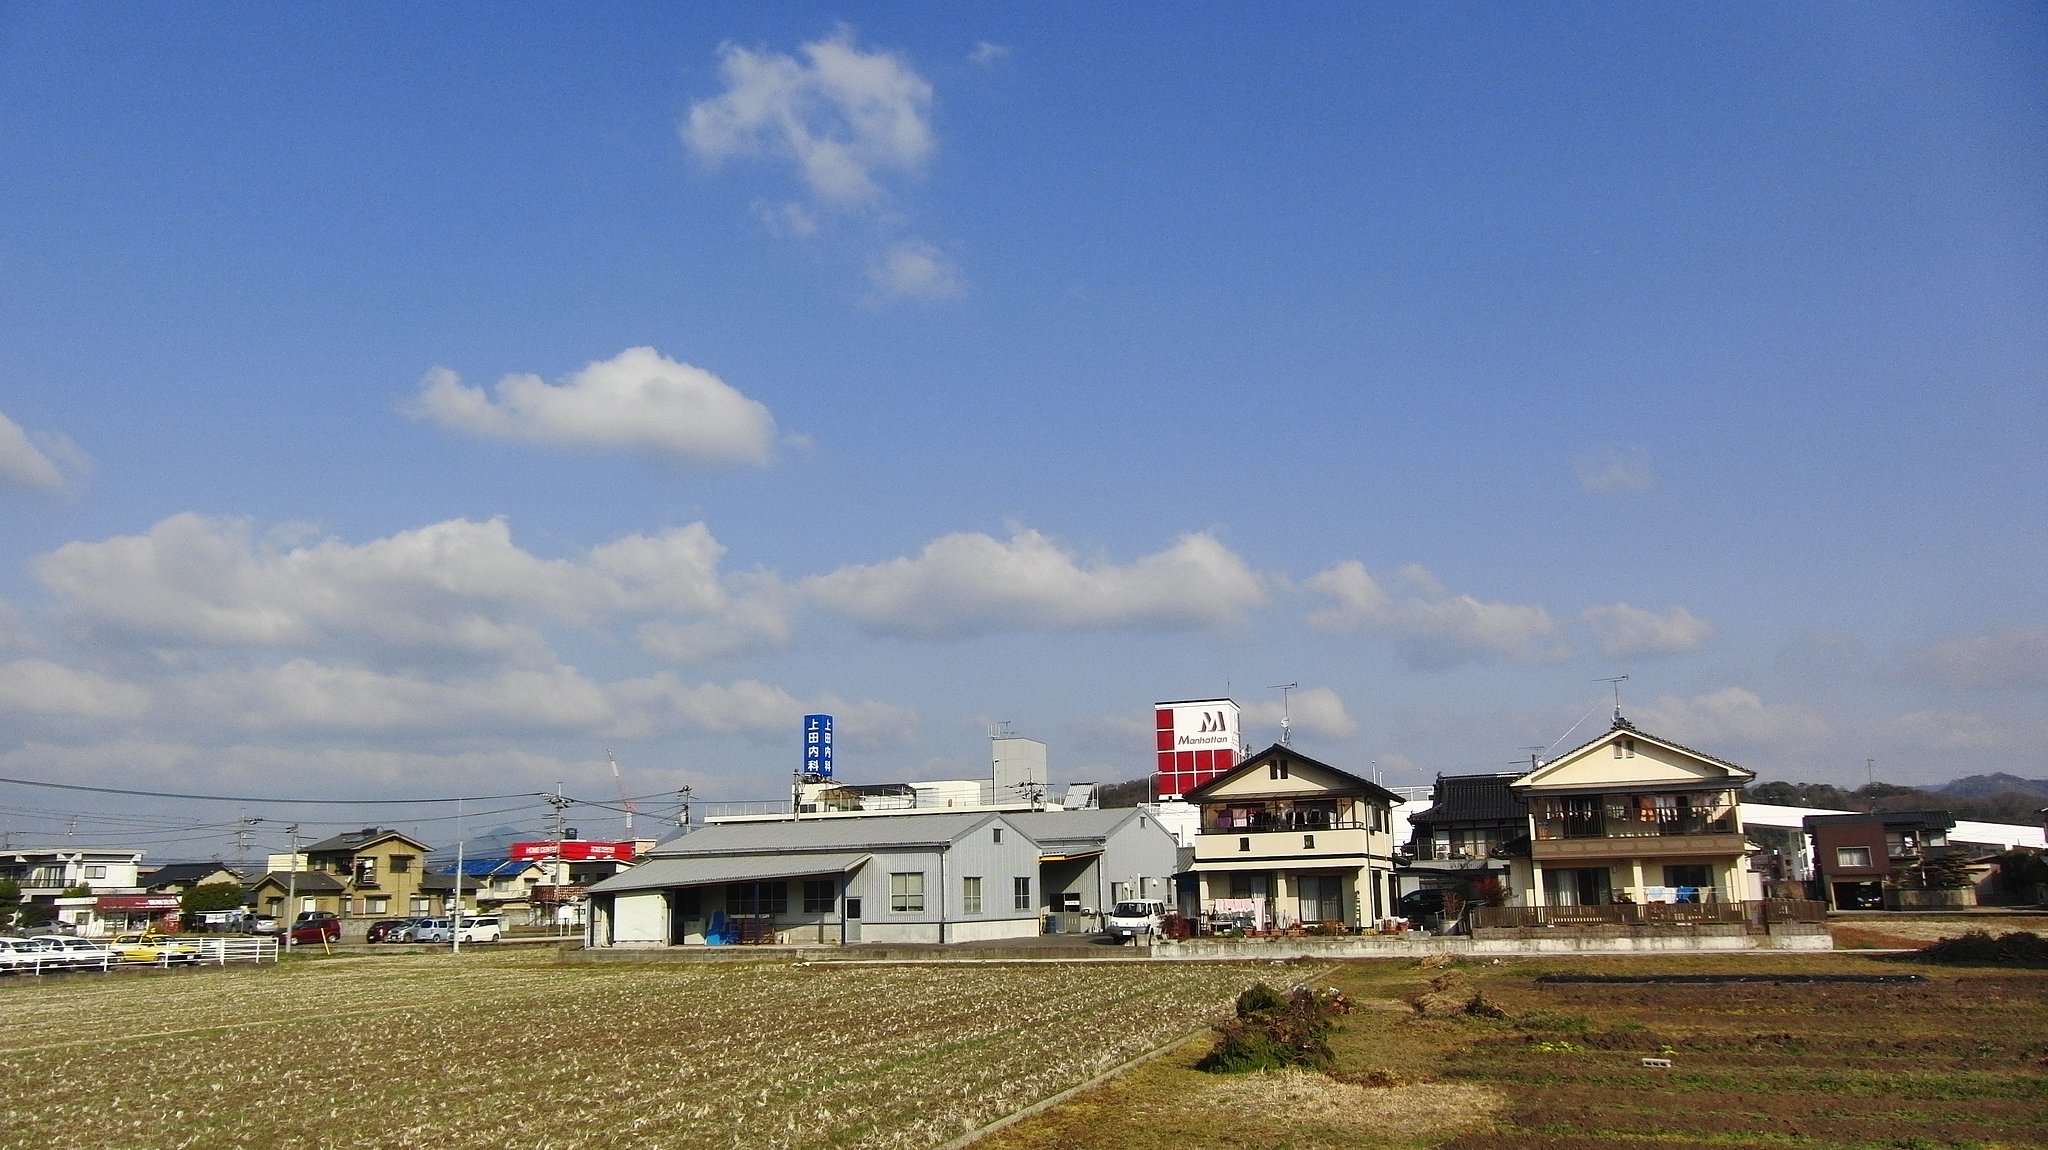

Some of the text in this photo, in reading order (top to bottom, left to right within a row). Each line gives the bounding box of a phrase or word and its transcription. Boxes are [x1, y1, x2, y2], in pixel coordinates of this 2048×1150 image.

[808, 718, 819, 771] 上田内科
[1178, 735, 1228, 745] Manhattan
